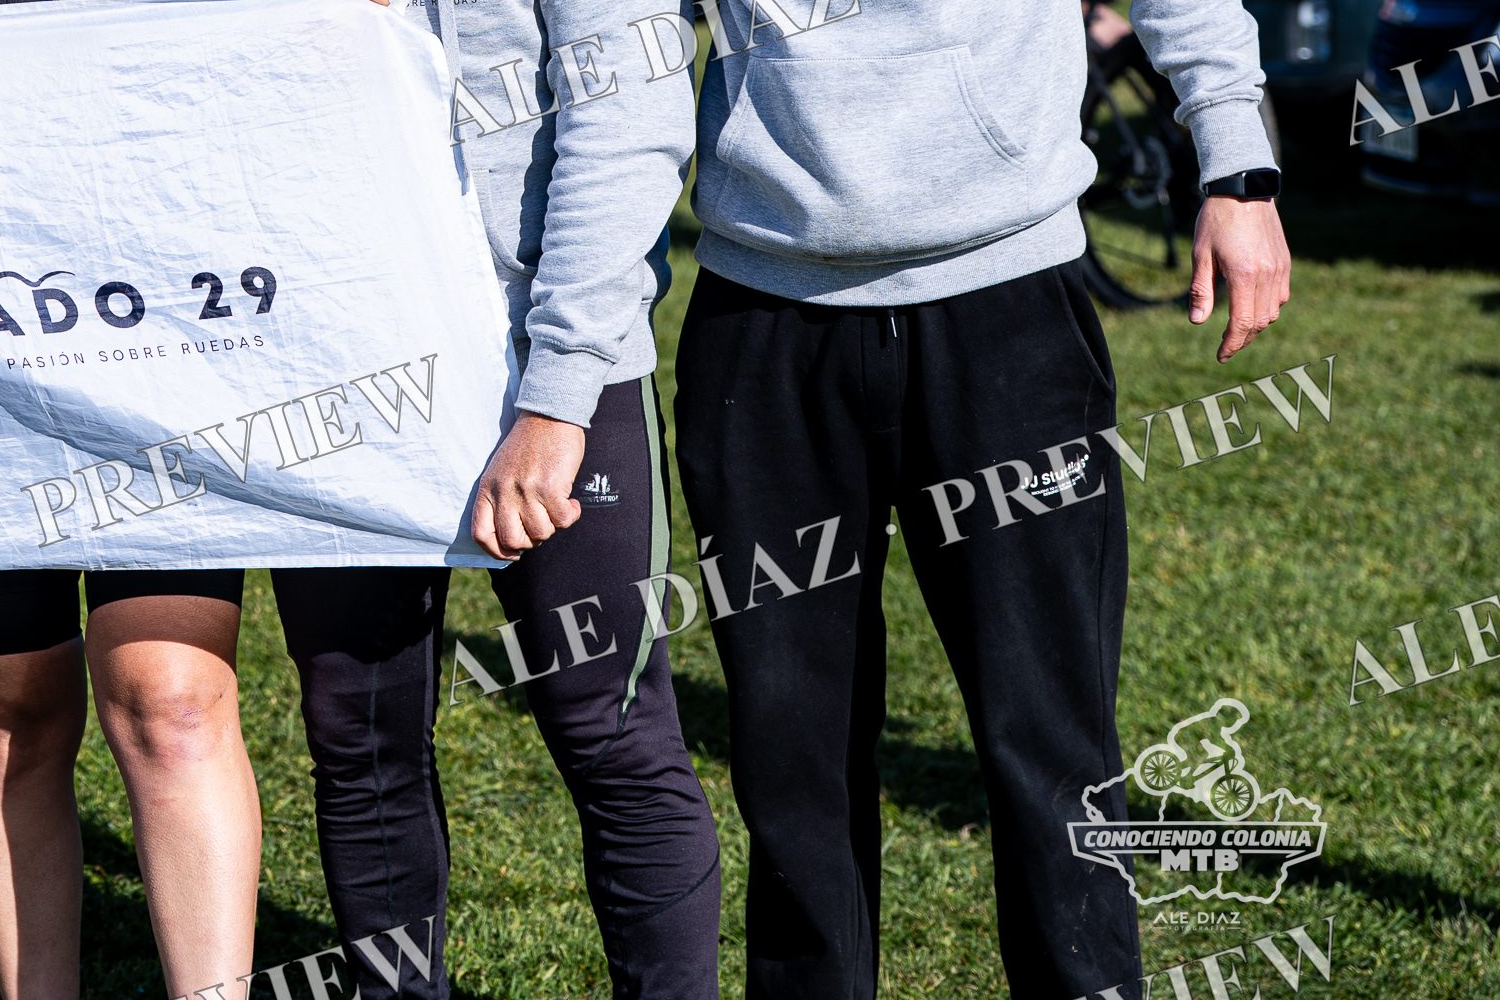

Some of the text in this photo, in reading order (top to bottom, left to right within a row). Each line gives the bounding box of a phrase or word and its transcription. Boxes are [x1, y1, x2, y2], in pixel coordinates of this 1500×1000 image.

[191, 266, 277, 320] 29
[7, 335, 265, 370] PASIÓN SOBRE RUEDAS
